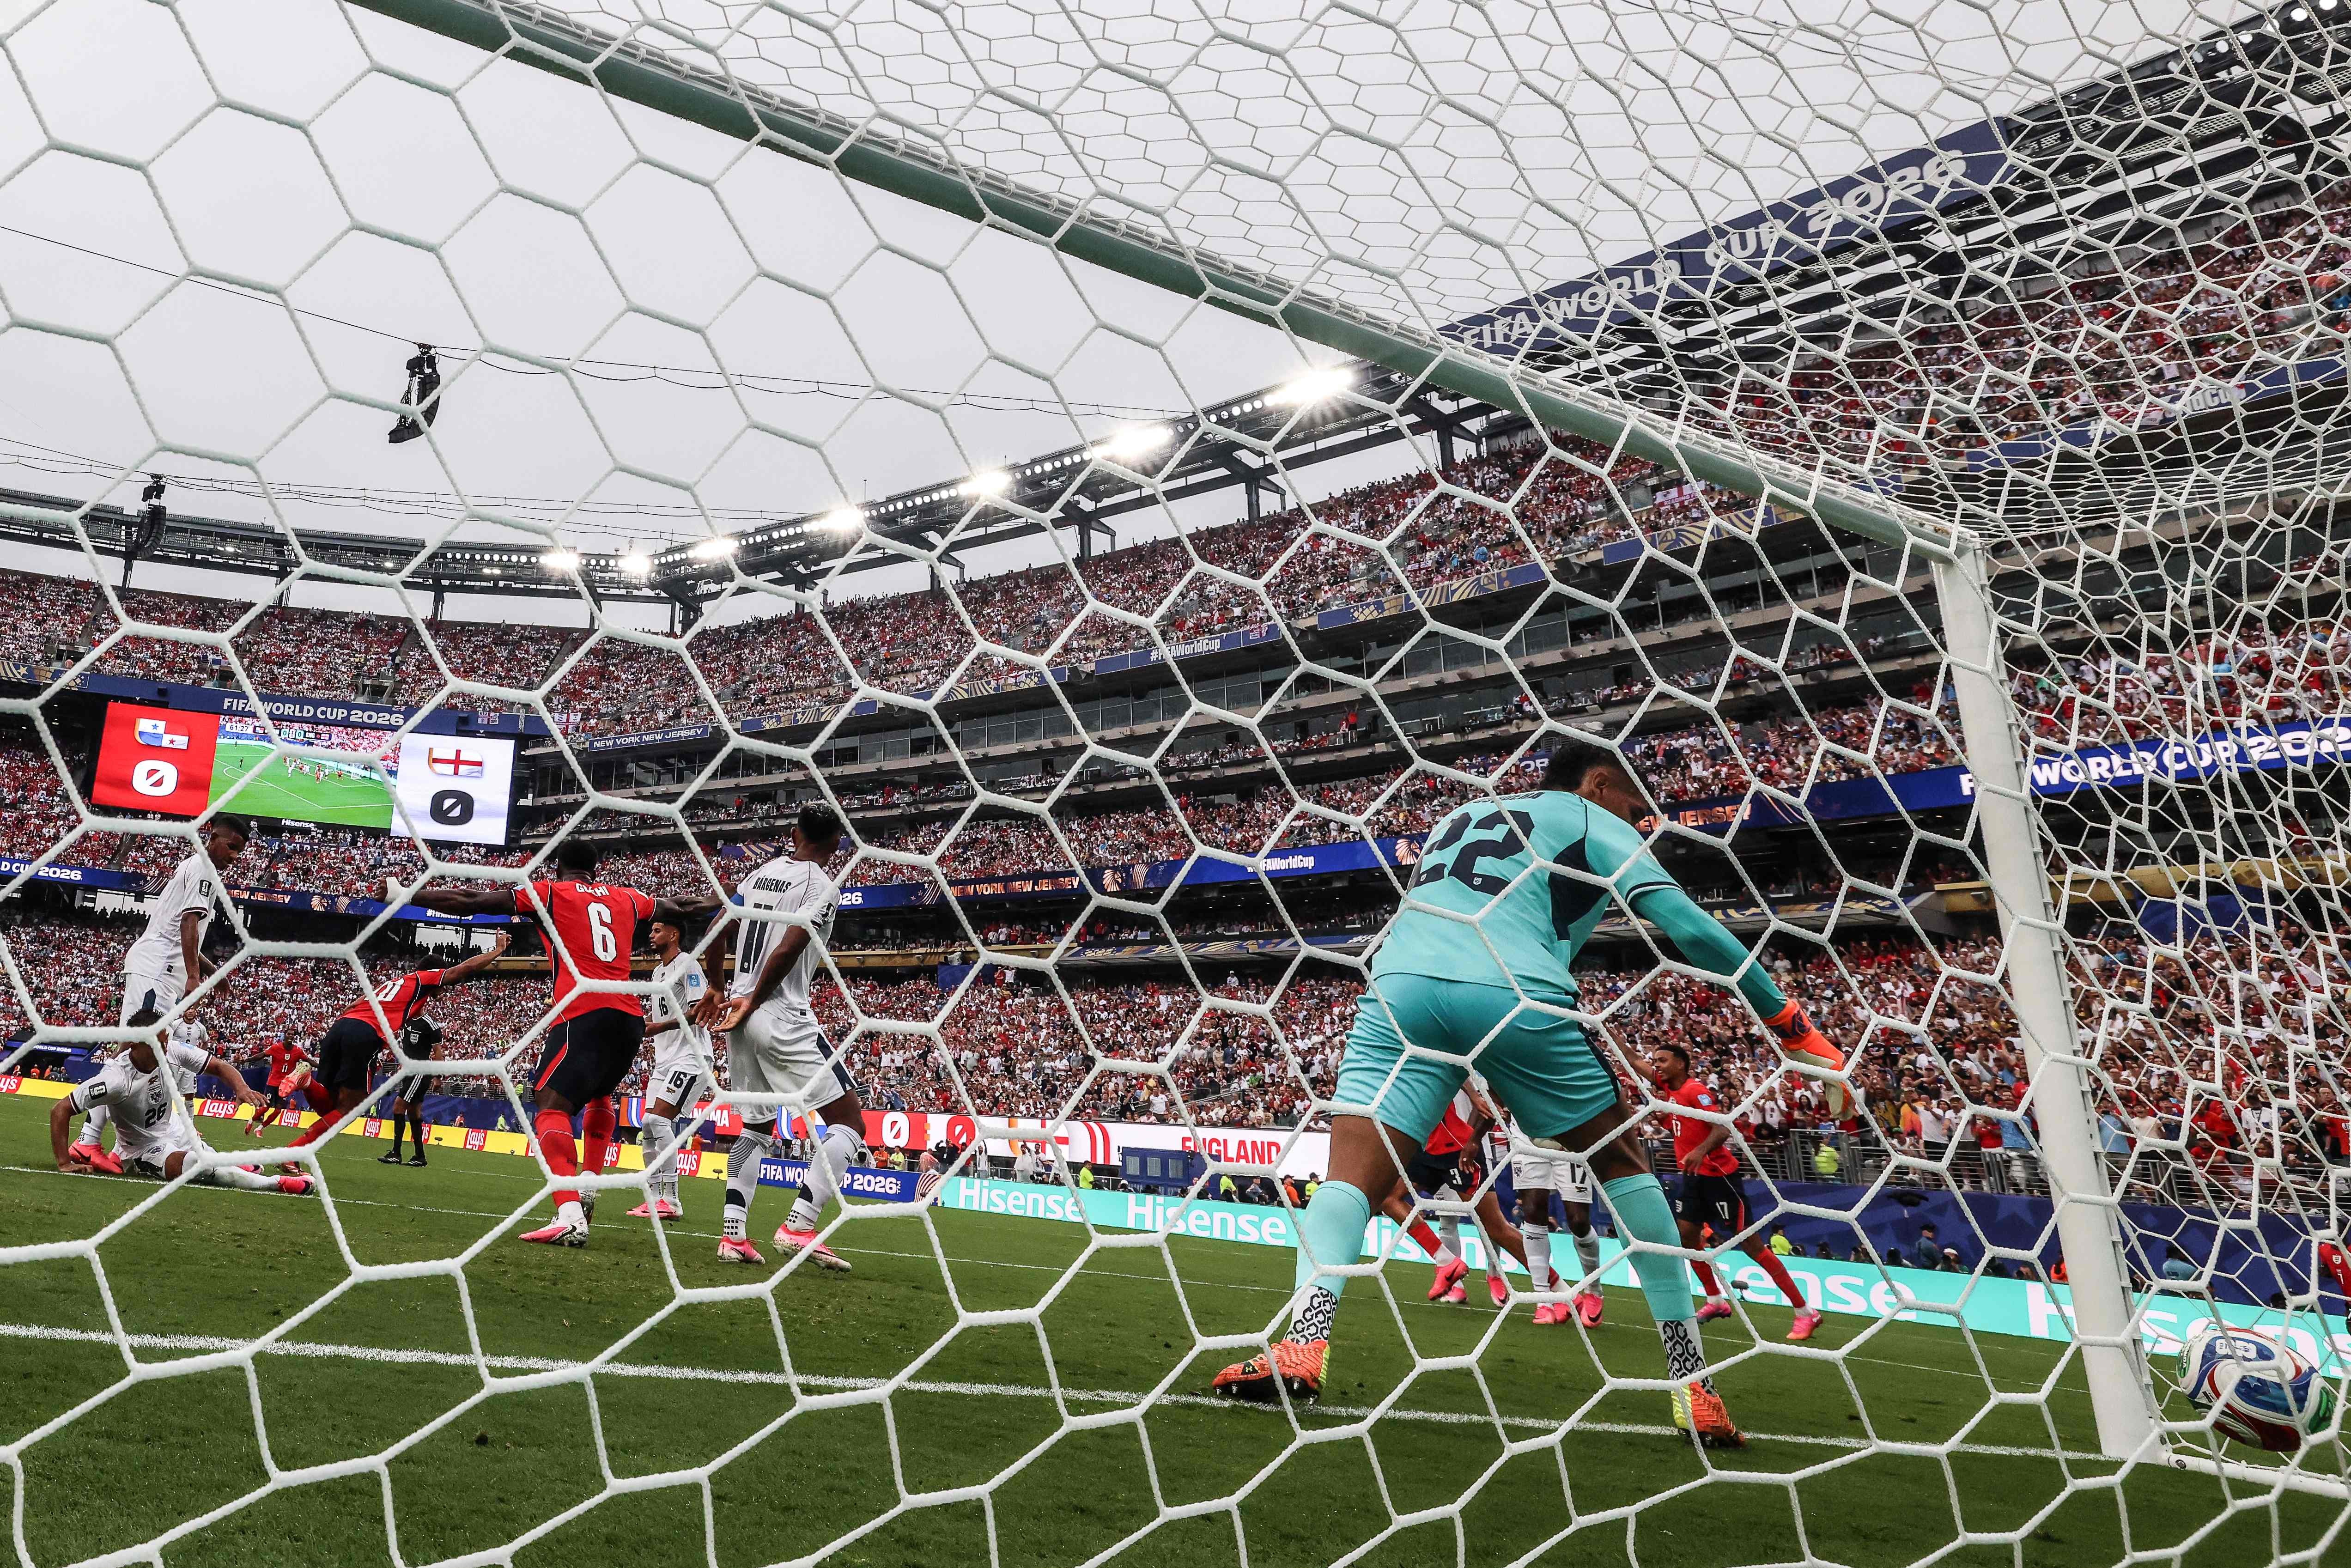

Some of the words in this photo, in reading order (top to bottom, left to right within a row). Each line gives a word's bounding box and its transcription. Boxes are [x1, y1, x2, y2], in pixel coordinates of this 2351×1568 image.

[1462, 311, 1535, 349] FIFA
[1549, 260, 1682, 324] WORLD
[1705, 219, 1785, 267] CUP
[1806, 150, 1967, 233] 2026
[1150, 638, 1220, 661] #FFAWorldCup
[223, 698, 257, 711] FIFA
[262, 701, 314, 717] WORLD
[316, 707, 347, 721] CUP
[349, 710, 405, 726] 2026
[594, 739, 614, 748] NEW
[616, 736, 640, 745] YORK
[642, 733, 663, 741] NEW
[665, 728, 703, 738] JERSEY
[2033, 750, 2158, 787] WORLD
[2163, 740, 2238, 771] CUP
[2246, 726, 2351, 761] 202
[132, 760, 178, 796] 0
[430, 790, 474, 825] 0
[281, 818, 315, 828] Hisense
[1407, 810, 1535, 899] 22
[12, 863, 32, 874] CU
[38, 866, 82, 881] 2026
[951, 884, 974, 897] NEW
[977, 882, 1005, 895] YORK
[1007, 880, 1033, 893] NEW
[1035, 876, 1079, 891] JERSEY
[251, 892, 291, 904] JERSEY
[587, 902, 617, 962] 6
[740, 902, 774, 973] 11
[659, 996, 669, 1017] 16
[668, 1070, 688, 1088] 16
[145, 1102, 167, 1129] 26
[203, 1100, 235, 1118] Lay's
[280, 1109, 299, 1127] Lay's
[365, 1118, 380, 1137] Lay's
[461, 1129, 480, 1149] Lay's
[1181, 1136, 1281, 1165] ENGLAND
[677, 1150, 698, 1175] ay's
[760, 1164, 784, 1181] FIFA
[853, 1173, 896, 1194] 2026
[1450, 1168, 1462, 1185] 3
[958, 1178, 1086, 1223] Hisense
[1715, 1202, 1729, 1219] 17
[1127, 1194, 1287, 1246] Hisense
